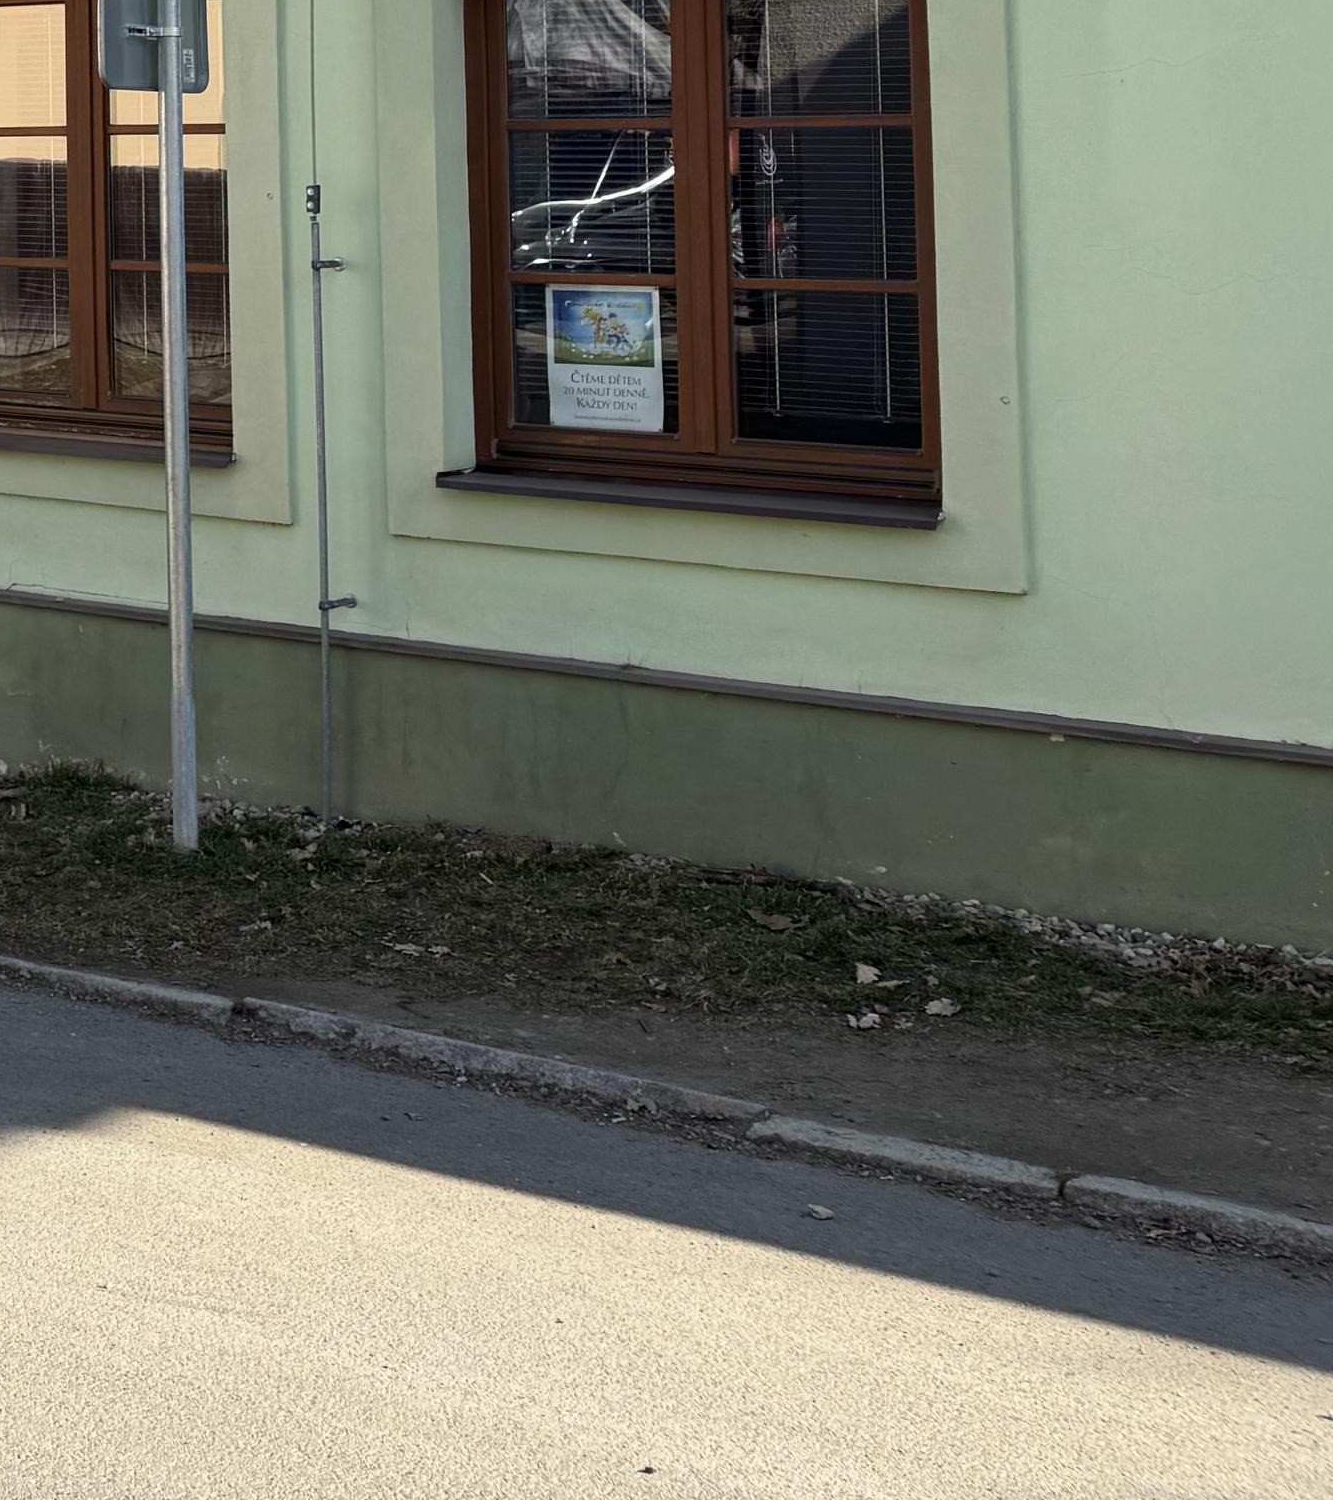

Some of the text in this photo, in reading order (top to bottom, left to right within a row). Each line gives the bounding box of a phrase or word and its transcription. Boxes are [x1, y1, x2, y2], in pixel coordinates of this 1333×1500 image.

[563, 386, 574, 395] 20
[576, 387, 611, 397] MINUT
[576, 397, 611, 410] KAŽDÝ
